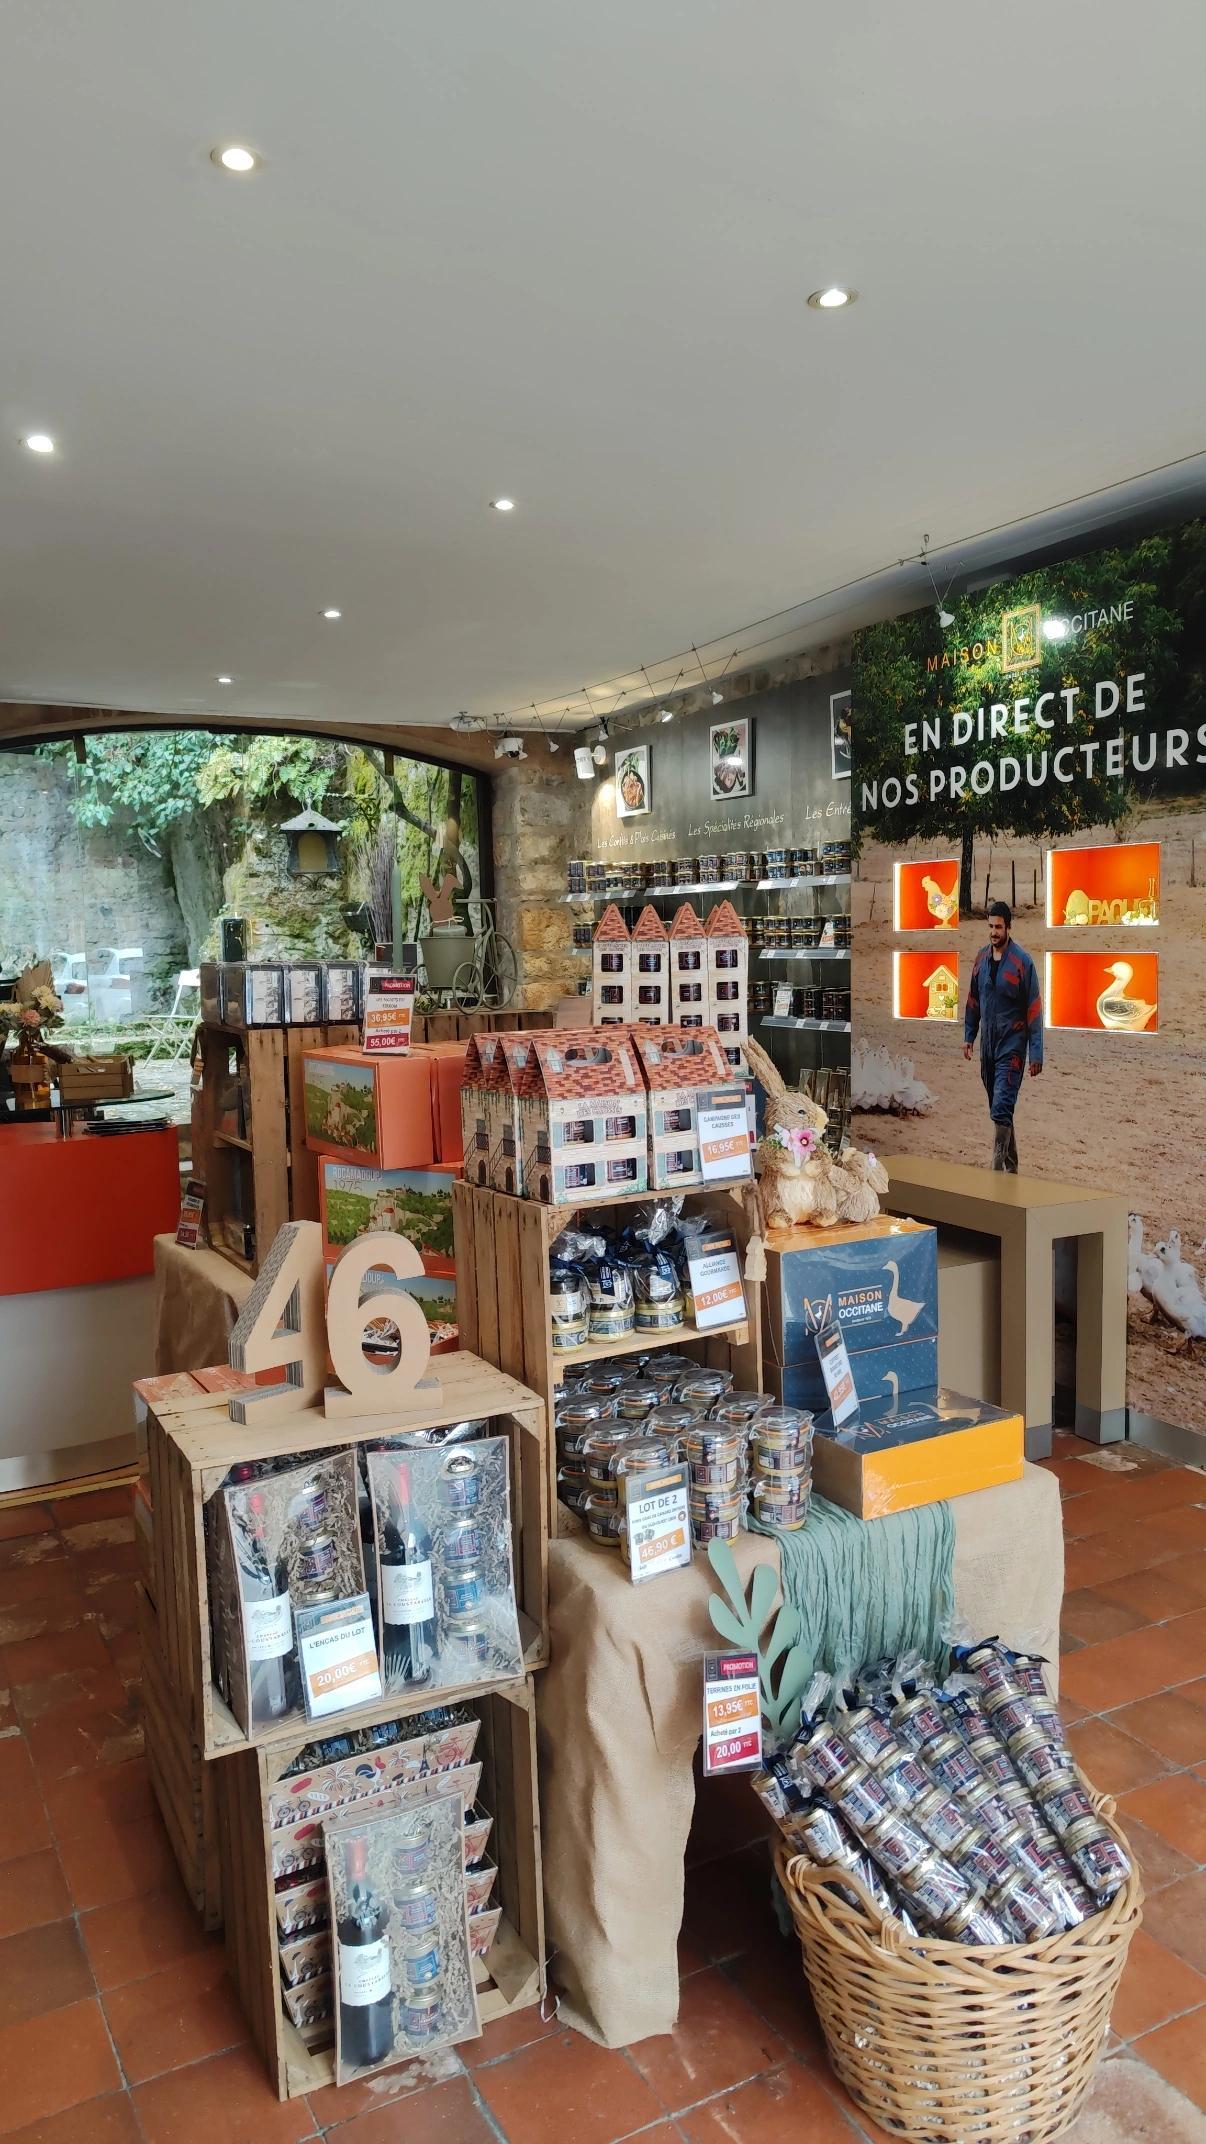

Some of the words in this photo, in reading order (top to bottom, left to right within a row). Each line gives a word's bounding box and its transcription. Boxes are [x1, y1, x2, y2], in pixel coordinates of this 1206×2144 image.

[927, 639, 997, 672] MAISON
[1045, 600, 1134, 638] CCITANE
[905, 718, 941, 755] EN
[953, 687, 1080, 745] DIRECT
[1095, 673, 1146, 718] DE
[862, 773, 919, 811] NOS
[930, 724, 1206, 801] PRODUCTEURS
[805, 805, 822, 820] Les
[688, 823, 701, 836] Les
[703, 818, 742, 837] Spécialités
[743, 809, 784, 831] Régionales
[597, 837, 608, 849] Les
[370, 1036, 396, 1047] 55,00€
[711, 1121, 734, 1129] CAUSSES
[707, 1140, 735, 1155] 16,95€
[702, 1258, 726, 1269] ALLIANCE
[700, 1289, 728, 1306] 12,00€
[838, 1290, 882, 1307] MAISON
[229, 1220, 442, 1418] 46
[838, 1302, 884, 1319] OCCITANE
[639, 1501, 656, 1514] LOT
[658, 1497, 670, 1508] DE
[672, 1494, 678, 1504] 2
[309, 1635, 339, 1649] L'ENCAS
[340, 1631, 351, 1640] DU
[351, 1626, 365, 1636] LOT
[317, 1662, 357, 1687] 20,00€
[723, 1661, 754, 1671] PROMOTION
[707, 1684, 733, 1695] TERRINES
[734, 1683, 740, 1692] EN
[741, 1682, 757, 1692] FOLIE
[713, 1699, 743, 1717] 13,95€
[744, 1699, 754, 1707] TTC
[710, 1728, 728, 1737] Acheté
[729, 1728, 738, 1736] par
[716, 1741, 742, 1759] 20,00
[743, 1740, 753, 1748] TTC
